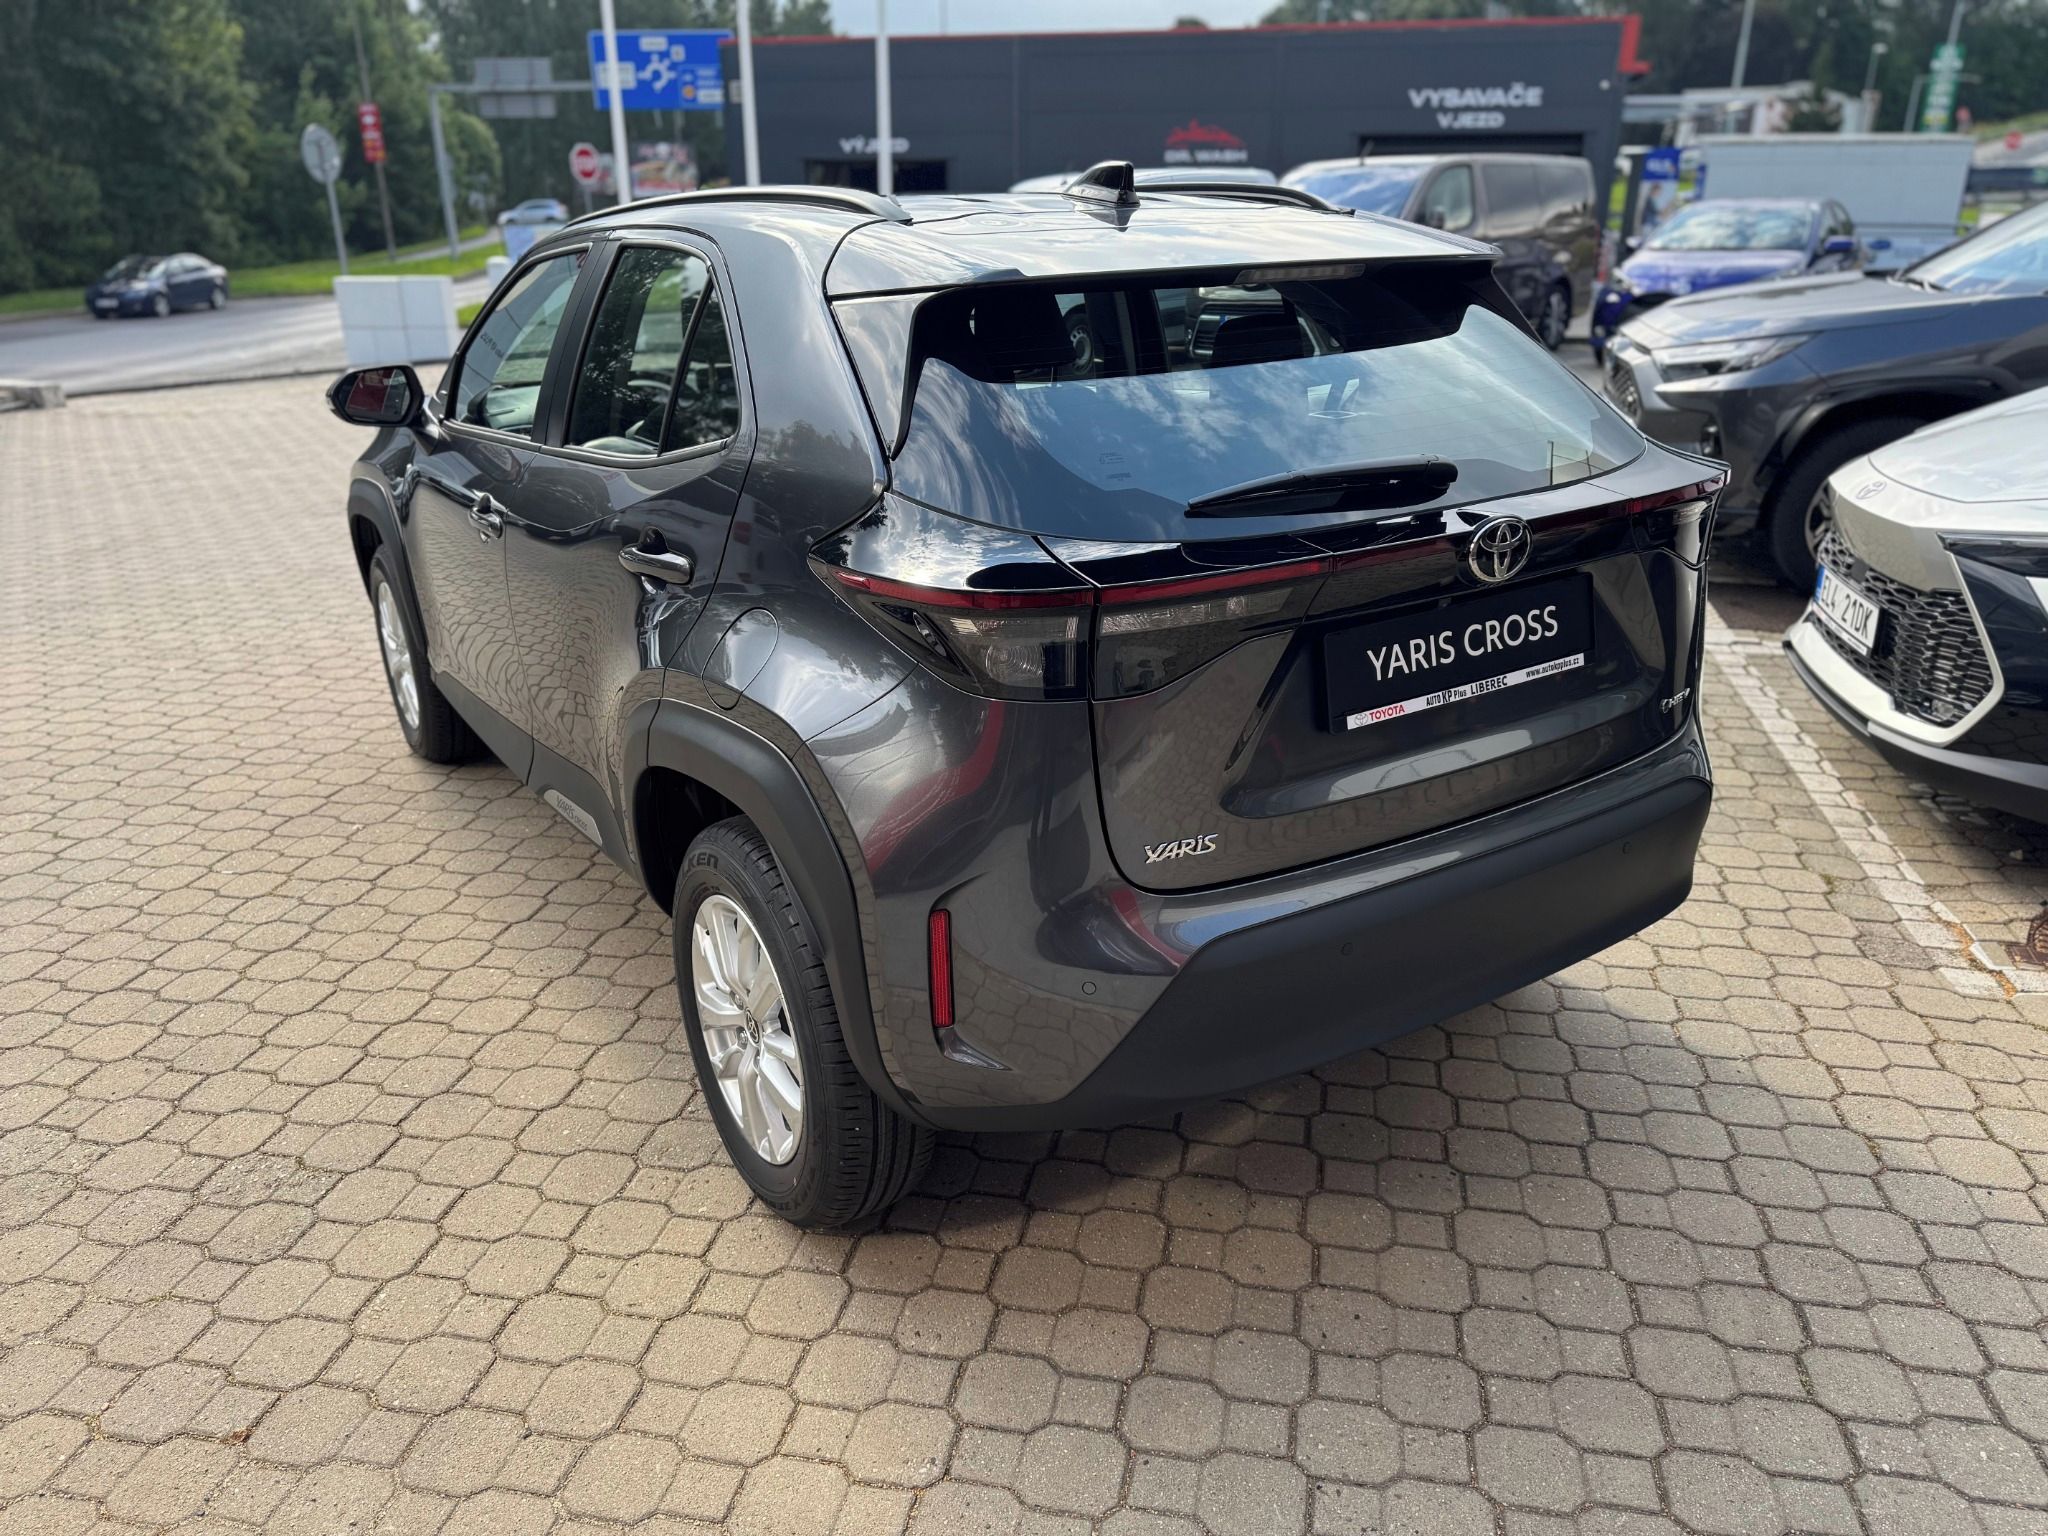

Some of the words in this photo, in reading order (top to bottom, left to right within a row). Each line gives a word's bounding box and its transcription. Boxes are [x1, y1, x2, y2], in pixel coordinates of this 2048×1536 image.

[1407, 81, 1543, 108] VYSAVAČE
[1436, 110, 1506, 129] VJEZD
[1841, 592, 1873, 640] 21DK
[1367, 631, 1455, 681] YARIS
[1464, 605, 1558, 657] CROSS
[1369, 704, 1406, 721] TOYOTA
[1426, 693, 1441, 707] AUTO
[1441, 689, 1453, 704] KP
[1454, 688, 1467, 699] Plus
[1470, 675, 1508, 695] LIBEREC
[1525, 657, 1580, 679] www.autokpplus.cz
[1144, 833, 1219, 865] YARIS
